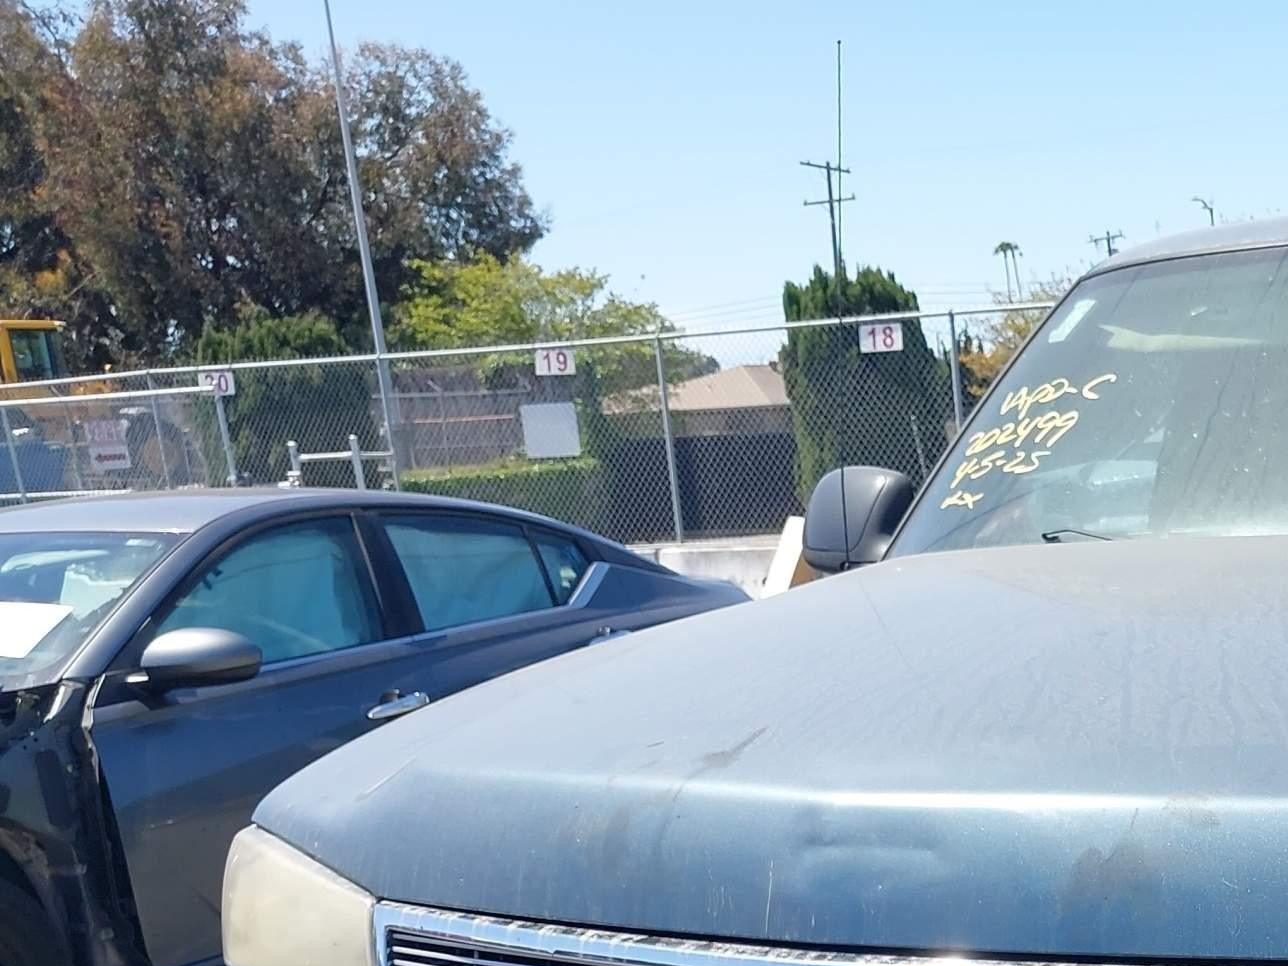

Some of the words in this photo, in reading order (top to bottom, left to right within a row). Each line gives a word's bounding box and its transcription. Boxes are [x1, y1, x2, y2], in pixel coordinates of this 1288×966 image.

[867, 326, 894, 350] 18
[543, 351, 567, 373] 19
[205, 374, 228, 393] 20
